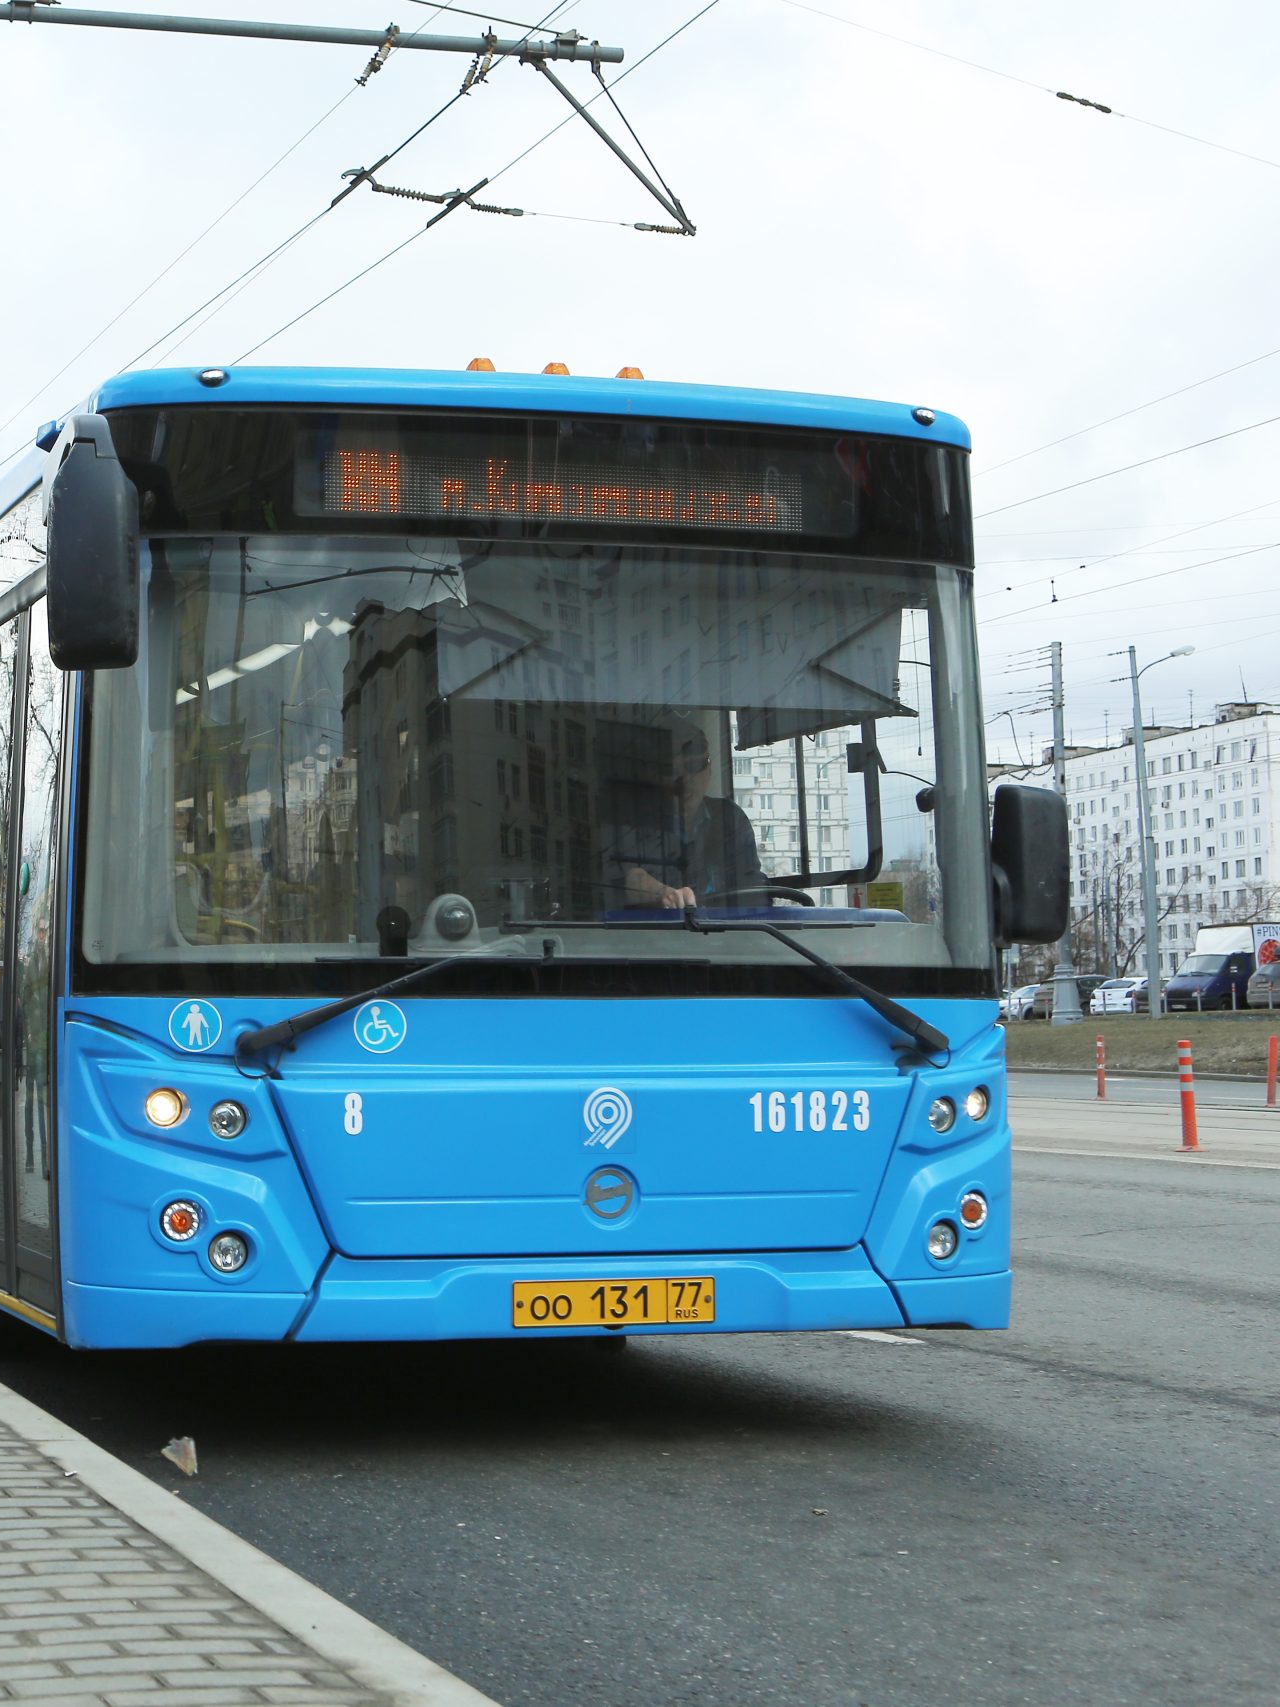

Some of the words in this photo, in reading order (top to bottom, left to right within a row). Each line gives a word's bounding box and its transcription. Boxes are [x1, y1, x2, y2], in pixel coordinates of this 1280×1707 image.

[1256, 926, 1280, 937] #PIN
[343, 1092, 364, 1136] 8
[748, 1090, 871, 1133] 161823
[590, 1285, 648, 1319] 131
[671, 1282, 703, 1308] 77
[675, 1308, 699, 1319] RUS
